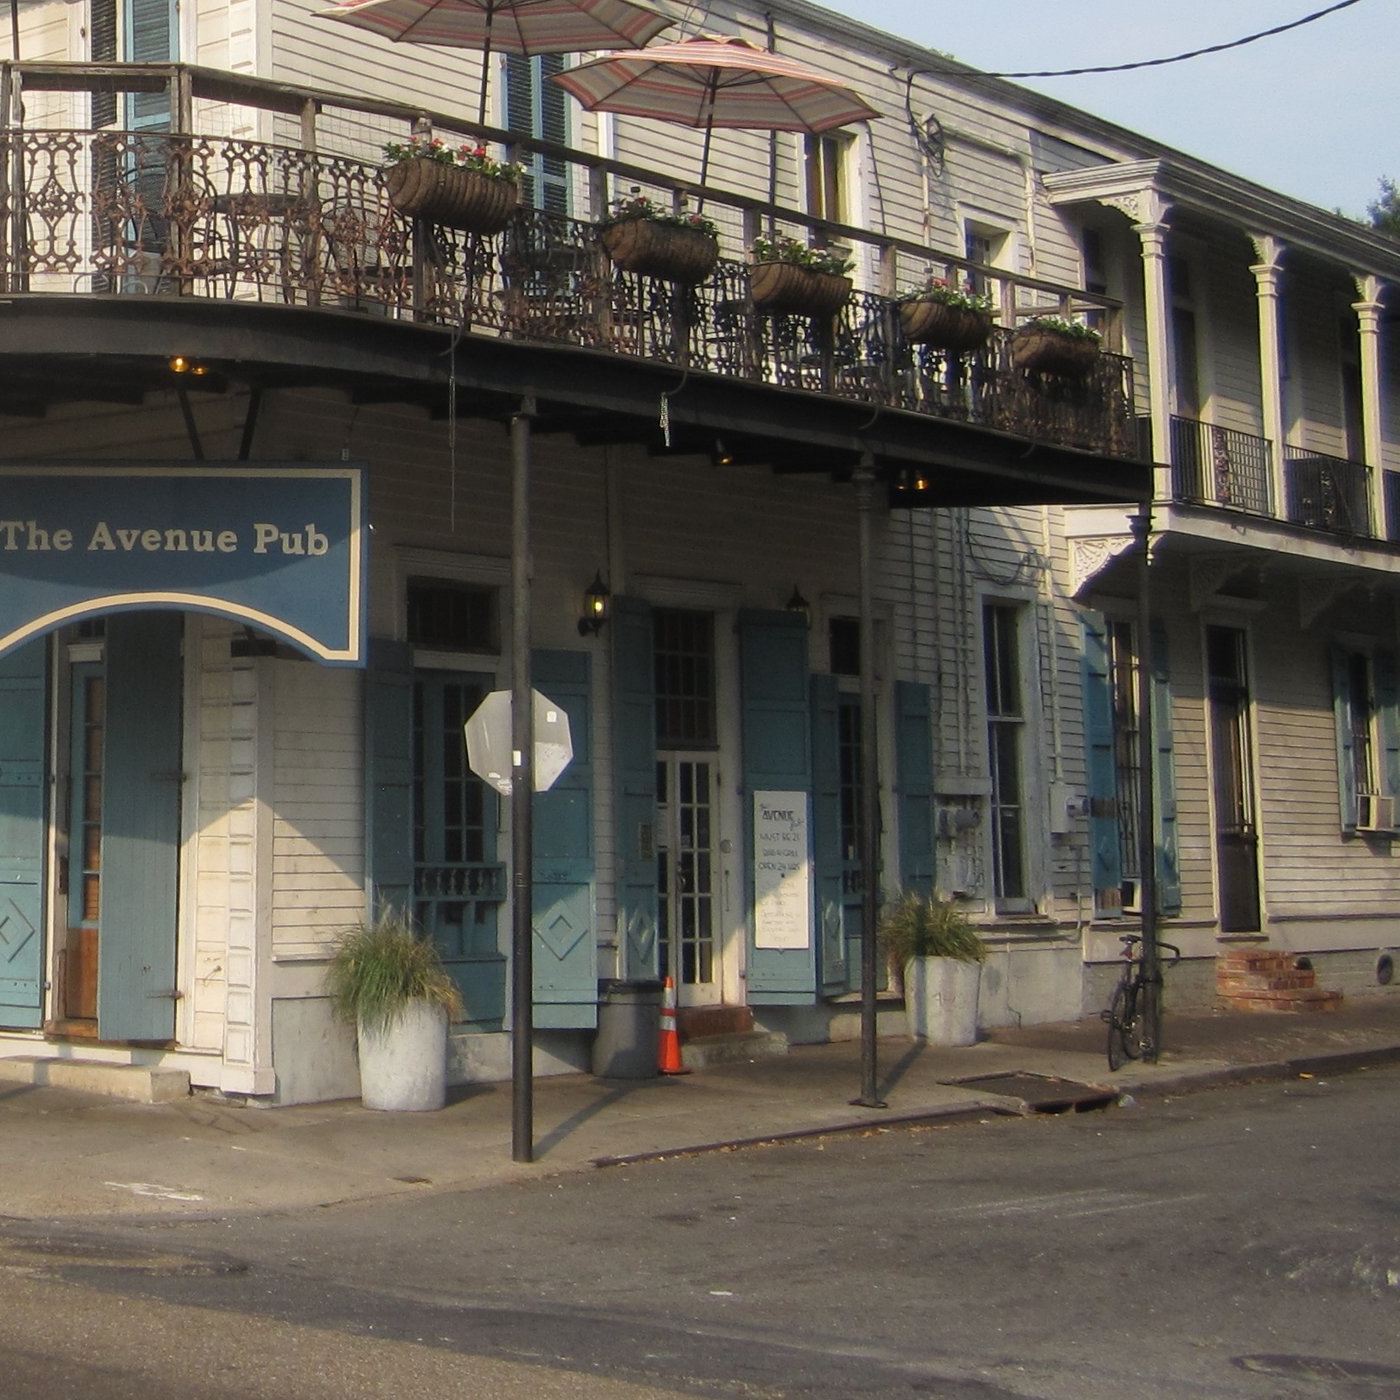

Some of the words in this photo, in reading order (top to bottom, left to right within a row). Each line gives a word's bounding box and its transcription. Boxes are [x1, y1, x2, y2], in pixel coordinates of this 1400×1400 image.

[0, 520, 73, 551] The
[87, 521, 238, 552] Avenue
[253, 523, 329, 556] Pub
[762, 810, 794, 821] AVENUE
